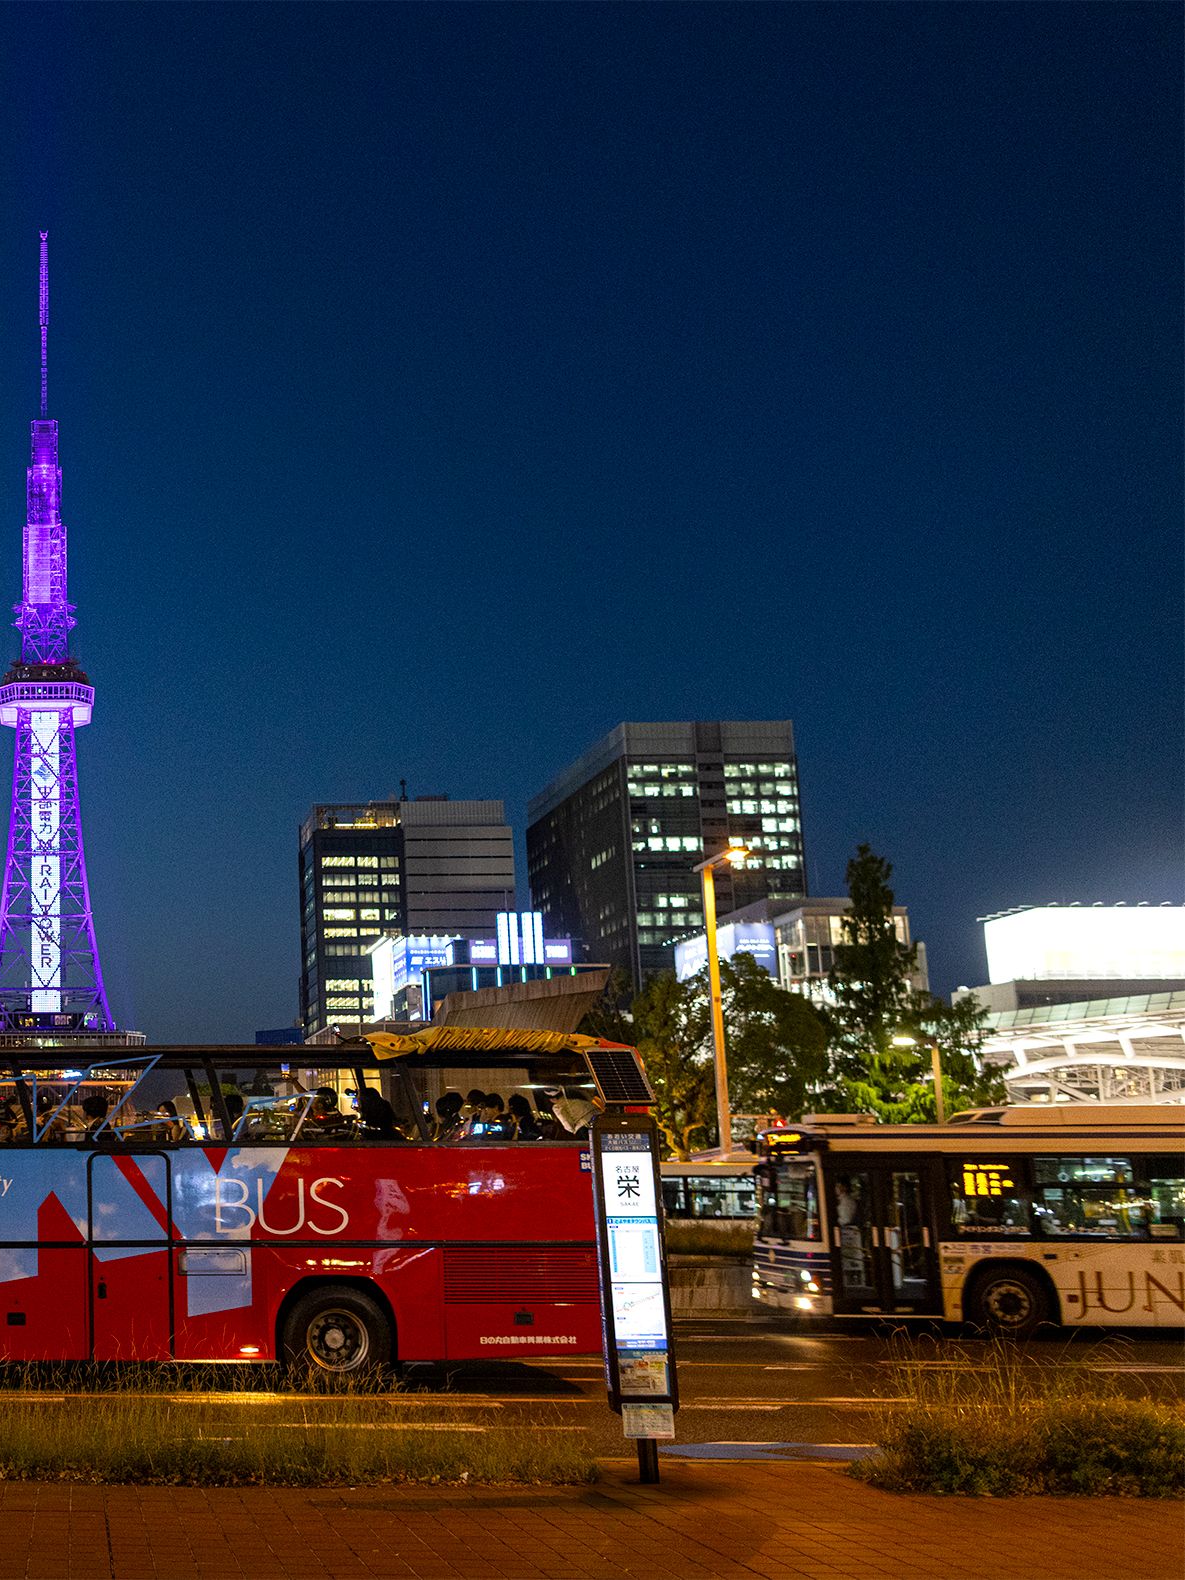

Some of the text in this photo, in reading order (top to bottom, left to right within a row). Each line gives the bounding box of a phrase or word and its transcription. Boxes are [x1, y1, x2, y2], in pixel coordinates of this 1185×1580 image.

[615, 1165, 640, 1174] 名古屋
[617, 1175, 641, 1198] 栄
[216, 1177, 350, 1235] BUS
